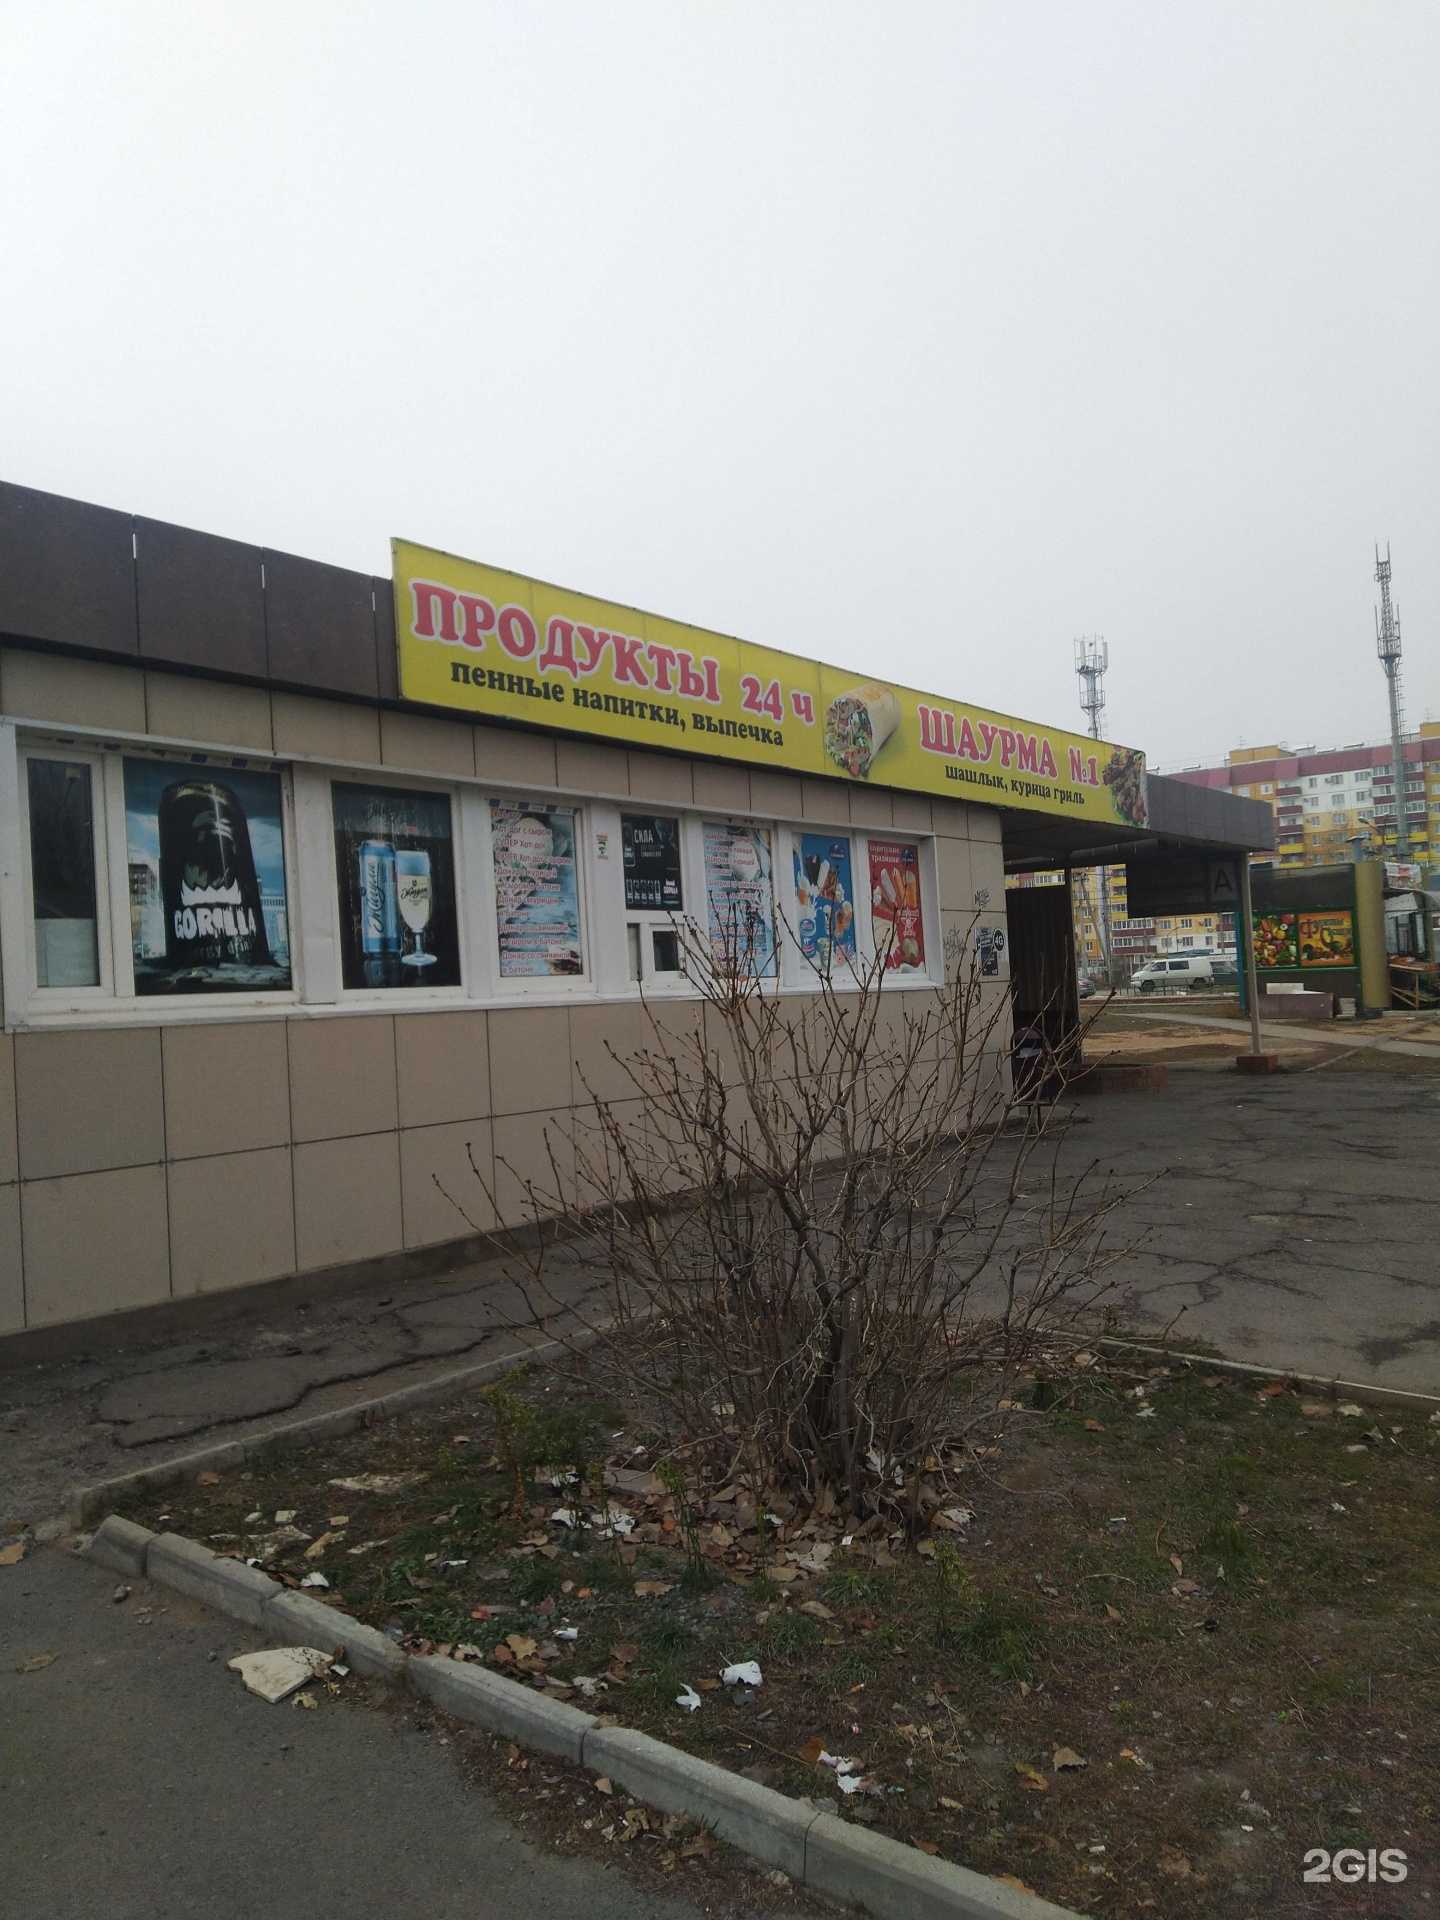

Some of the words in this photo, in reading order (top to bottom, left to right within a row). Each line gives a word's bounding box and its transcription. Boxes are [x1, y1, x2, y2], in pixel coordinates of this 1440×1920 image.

[411, 581, 721, 703] ПРОДУКТЫ
[740, 676, 784, 722] 24
[450, 660, 566, 702] пенные
[572, 687, 686, 732] напитки,
[692, 711, 784, 747] выпечка
[918, 704, 1058, 779] ШАУРМА
[1068, 748, 1100, 787] №1
[944, 764, 1009, 793] шашлык,
[1010, 778, 1051, 800] курица
[1053, 787, 1086, 805] гриль
[633, 828, 654, 844] СИЛА
[174, 906, 257, 940] GORILLA
